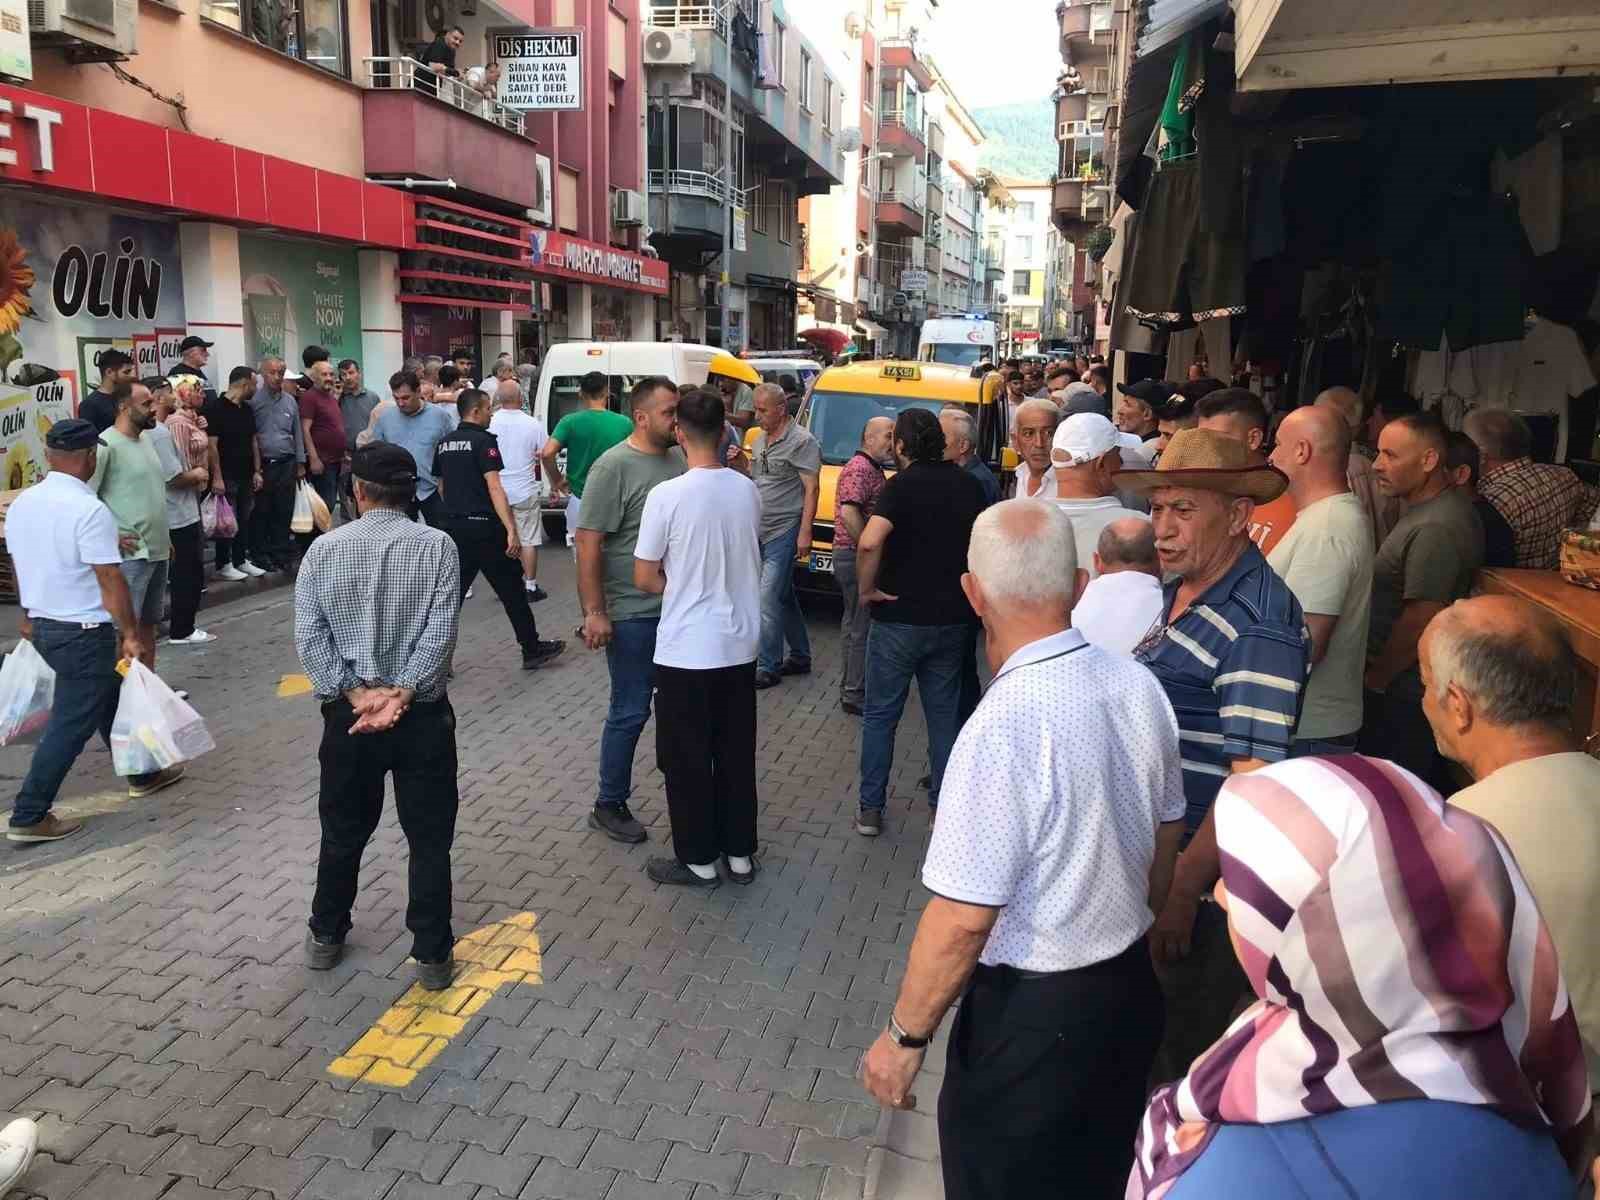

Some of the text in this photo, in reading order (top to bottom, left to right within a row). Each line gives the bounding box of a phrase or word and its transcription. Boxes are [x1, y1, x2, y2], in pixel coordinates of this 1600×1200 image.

[524, 37, 572, 56] HEKİMİ
[543, 62, 566, 72] KAYA
[543, 73, 566, 82] KAYA
[508, 83, 568, 92] SAMET DEDE
[502, 95, 533, 104] HAMZA
[314, 293, 344, 309] WHITE
[315, 308, 344, 328] NOW
[816, 556, 832, 569] 67
